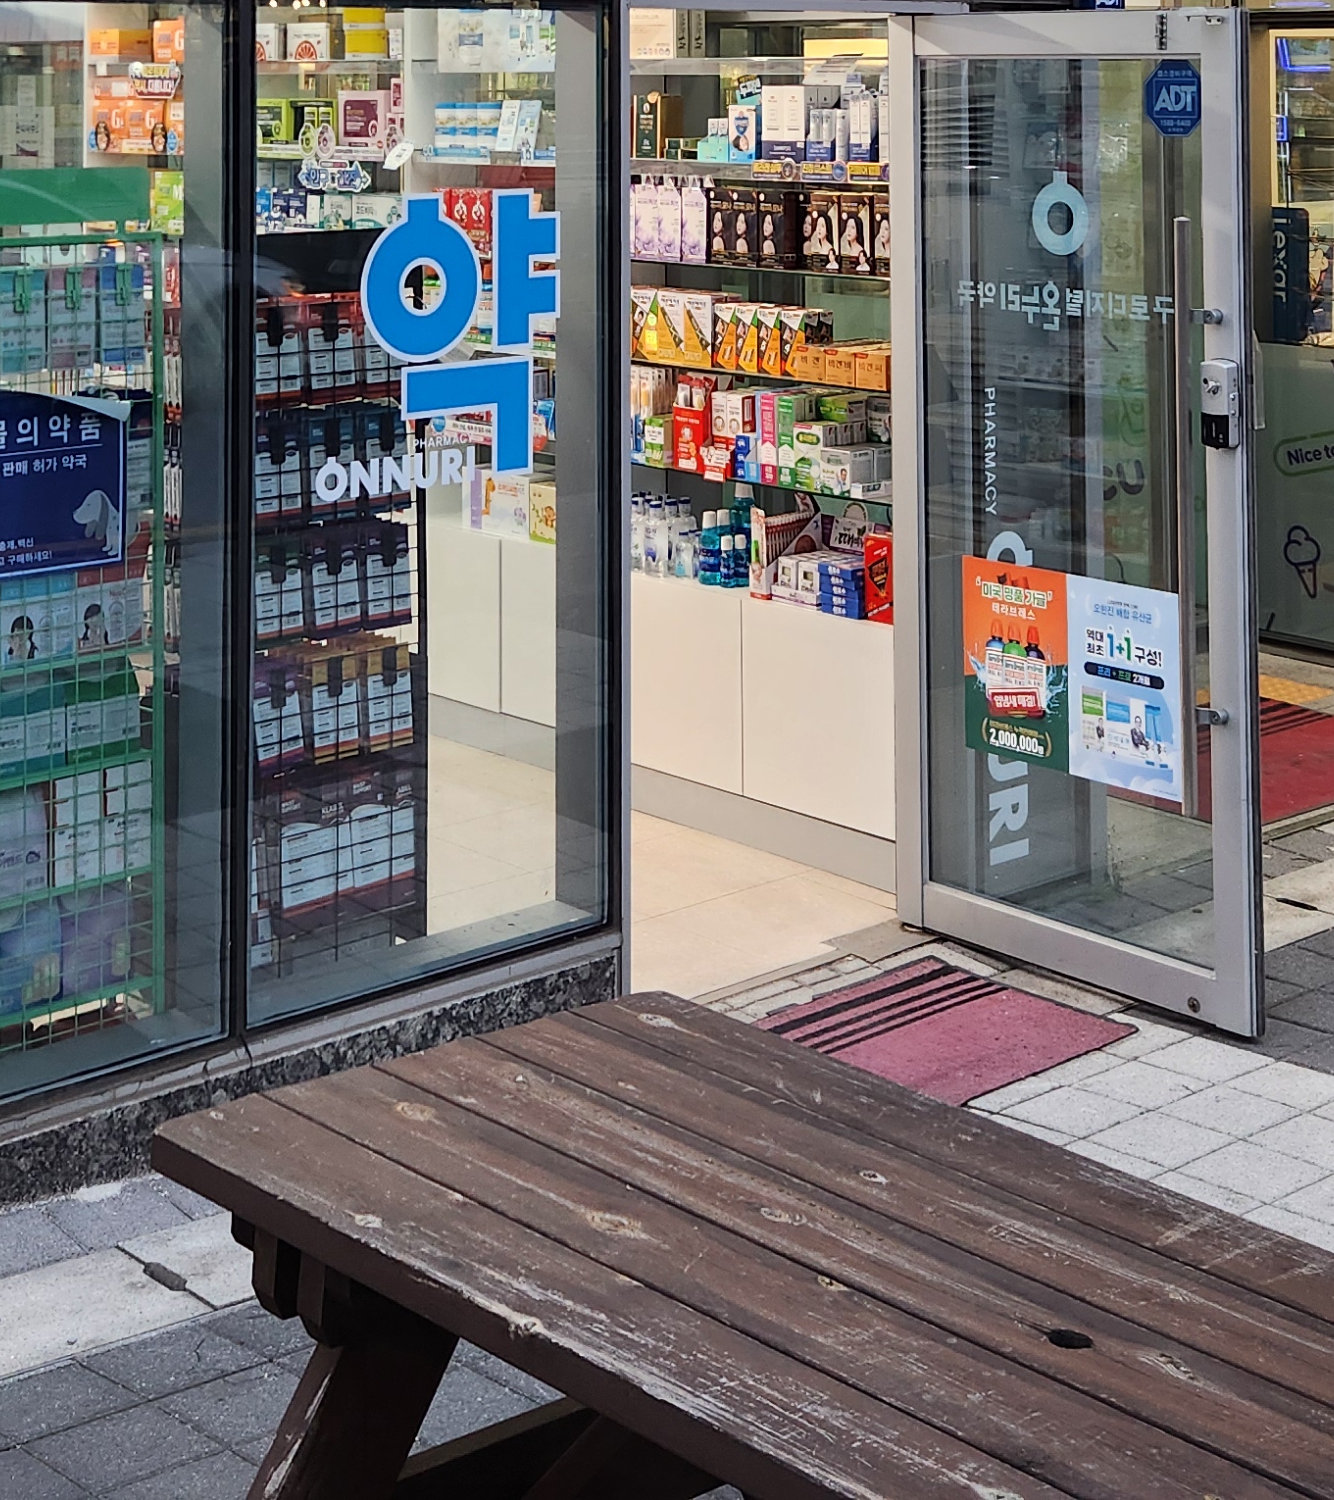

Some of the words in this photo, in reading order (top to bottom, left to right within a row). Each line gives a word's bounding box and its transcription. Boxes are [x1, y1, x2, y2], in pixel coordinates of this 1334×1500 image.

[1154, 84, 1198, 112] ADT
[361, 188, 562, 476] 약
[412, 434, 475, 449] PHARMACY
[983, 386, 997, 517] PHARMACY
[1286, 445, 1323, 466] Nice
[32, 457, 58, 474] 허가
[61, 454, 88, 470] 약국
[315, 445, 476, 502] ONNURI
[1086, 628, 1105, 643] 역대
[1107, 632, 1132, 662] 1+1
[1134, 646, 1163, 668] 구성!
